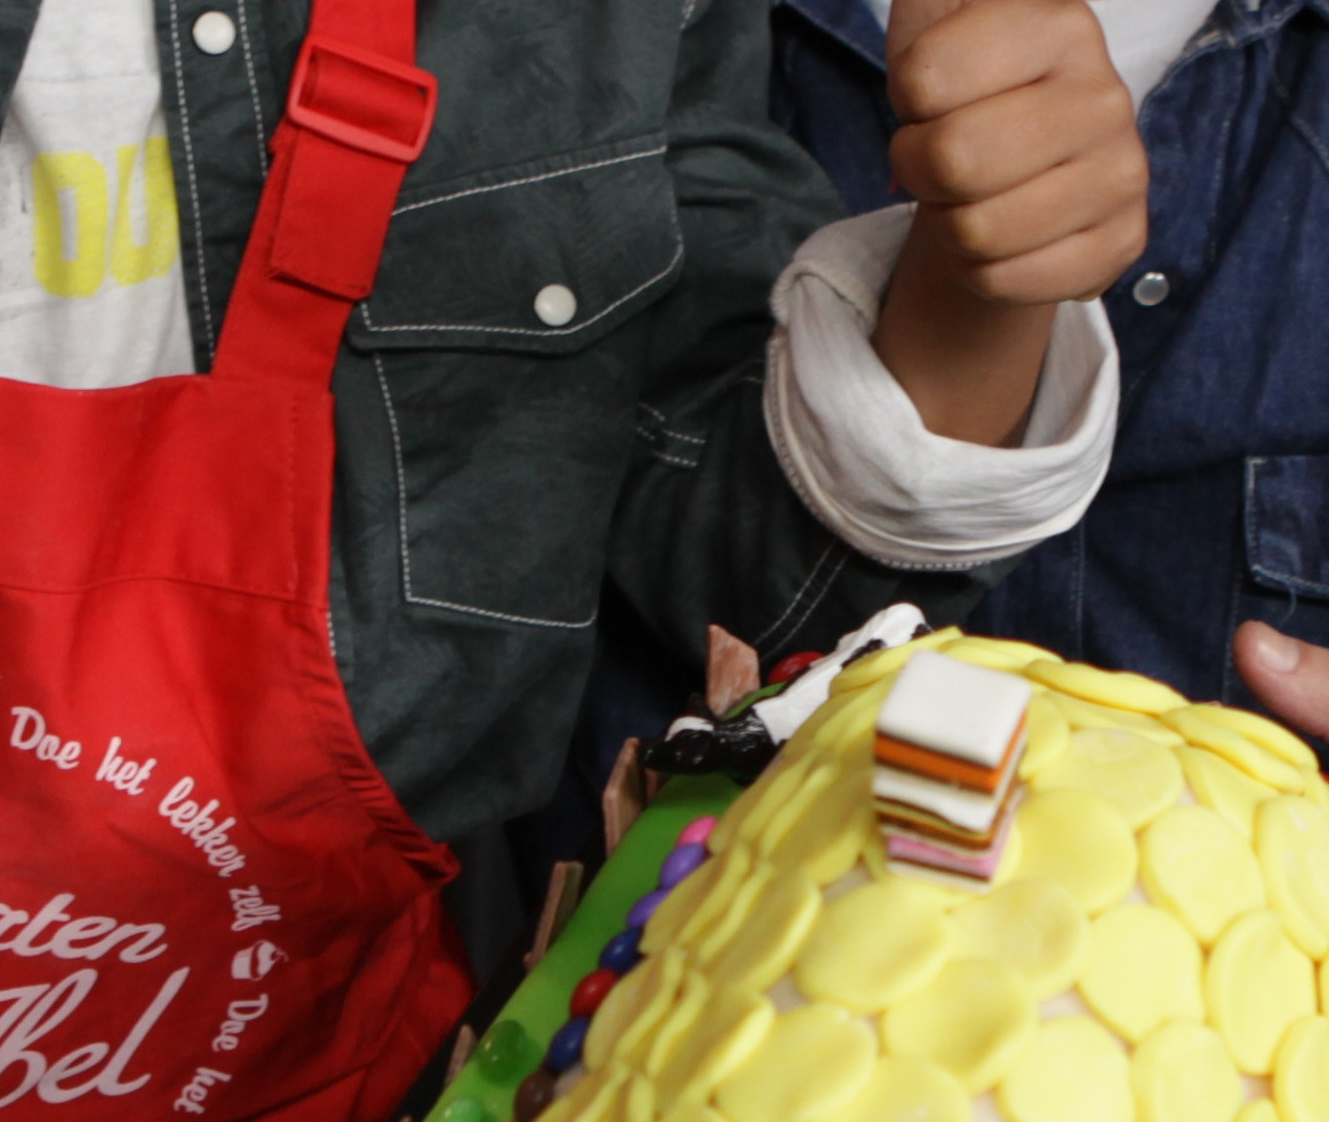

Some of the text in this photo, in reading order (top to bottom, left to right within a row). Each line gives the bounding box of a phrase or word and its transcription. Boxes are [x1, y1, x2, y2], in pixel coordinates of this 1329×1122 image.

[10, 706, 282, 932] Doe het lekker zelf
[173, 993, 270, 1115] Doe het
